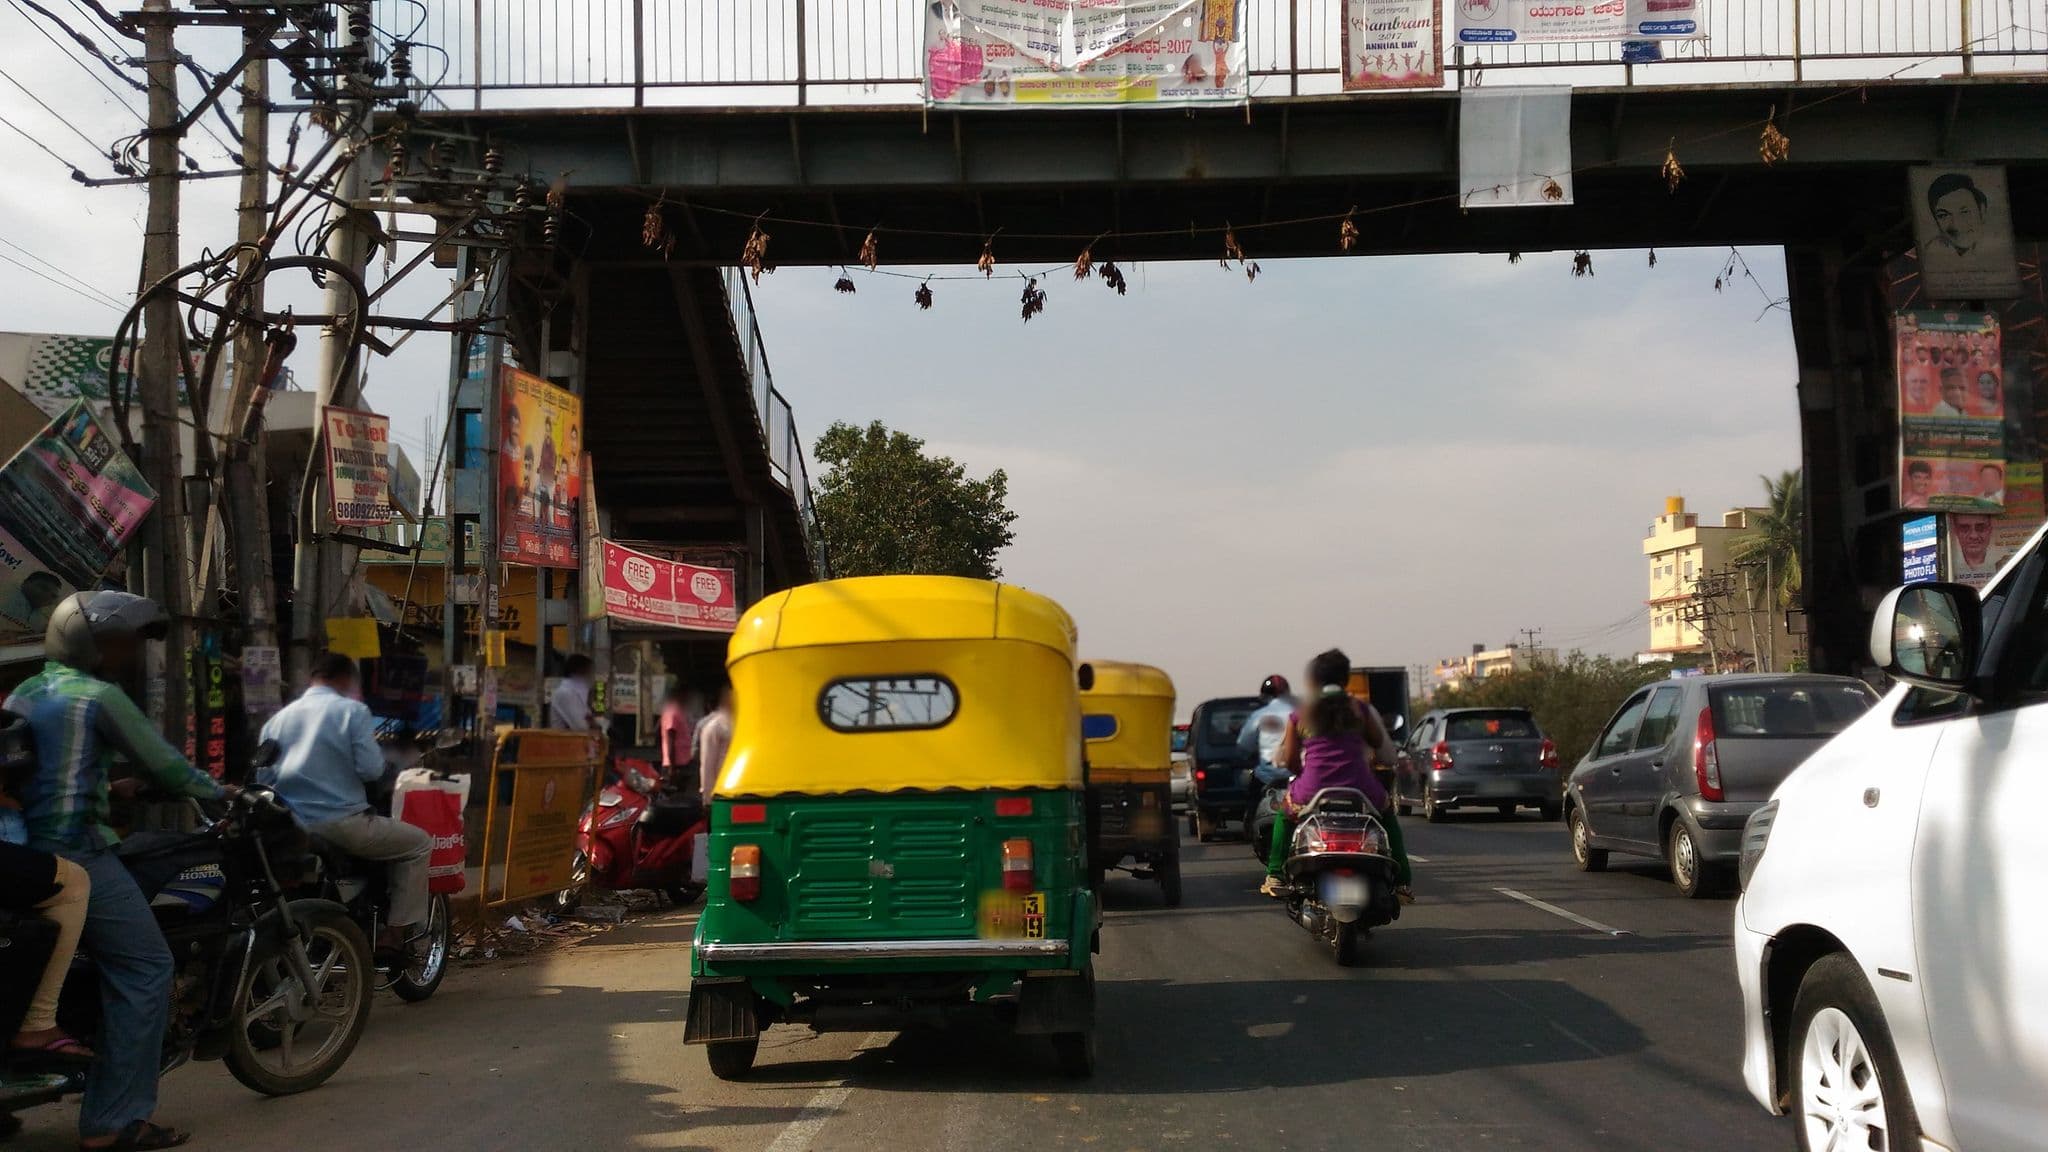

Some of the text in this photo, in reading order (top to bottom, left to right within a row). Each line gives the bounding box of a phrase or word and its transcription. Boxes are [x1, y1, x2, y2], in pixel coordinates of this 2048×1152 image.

[1401, 41, 1418, 49] DAY
[628, 561, 650, 579] FREE
[695, 576, 717, 591] FREE
[180, 870, 224, 881] HONDA
